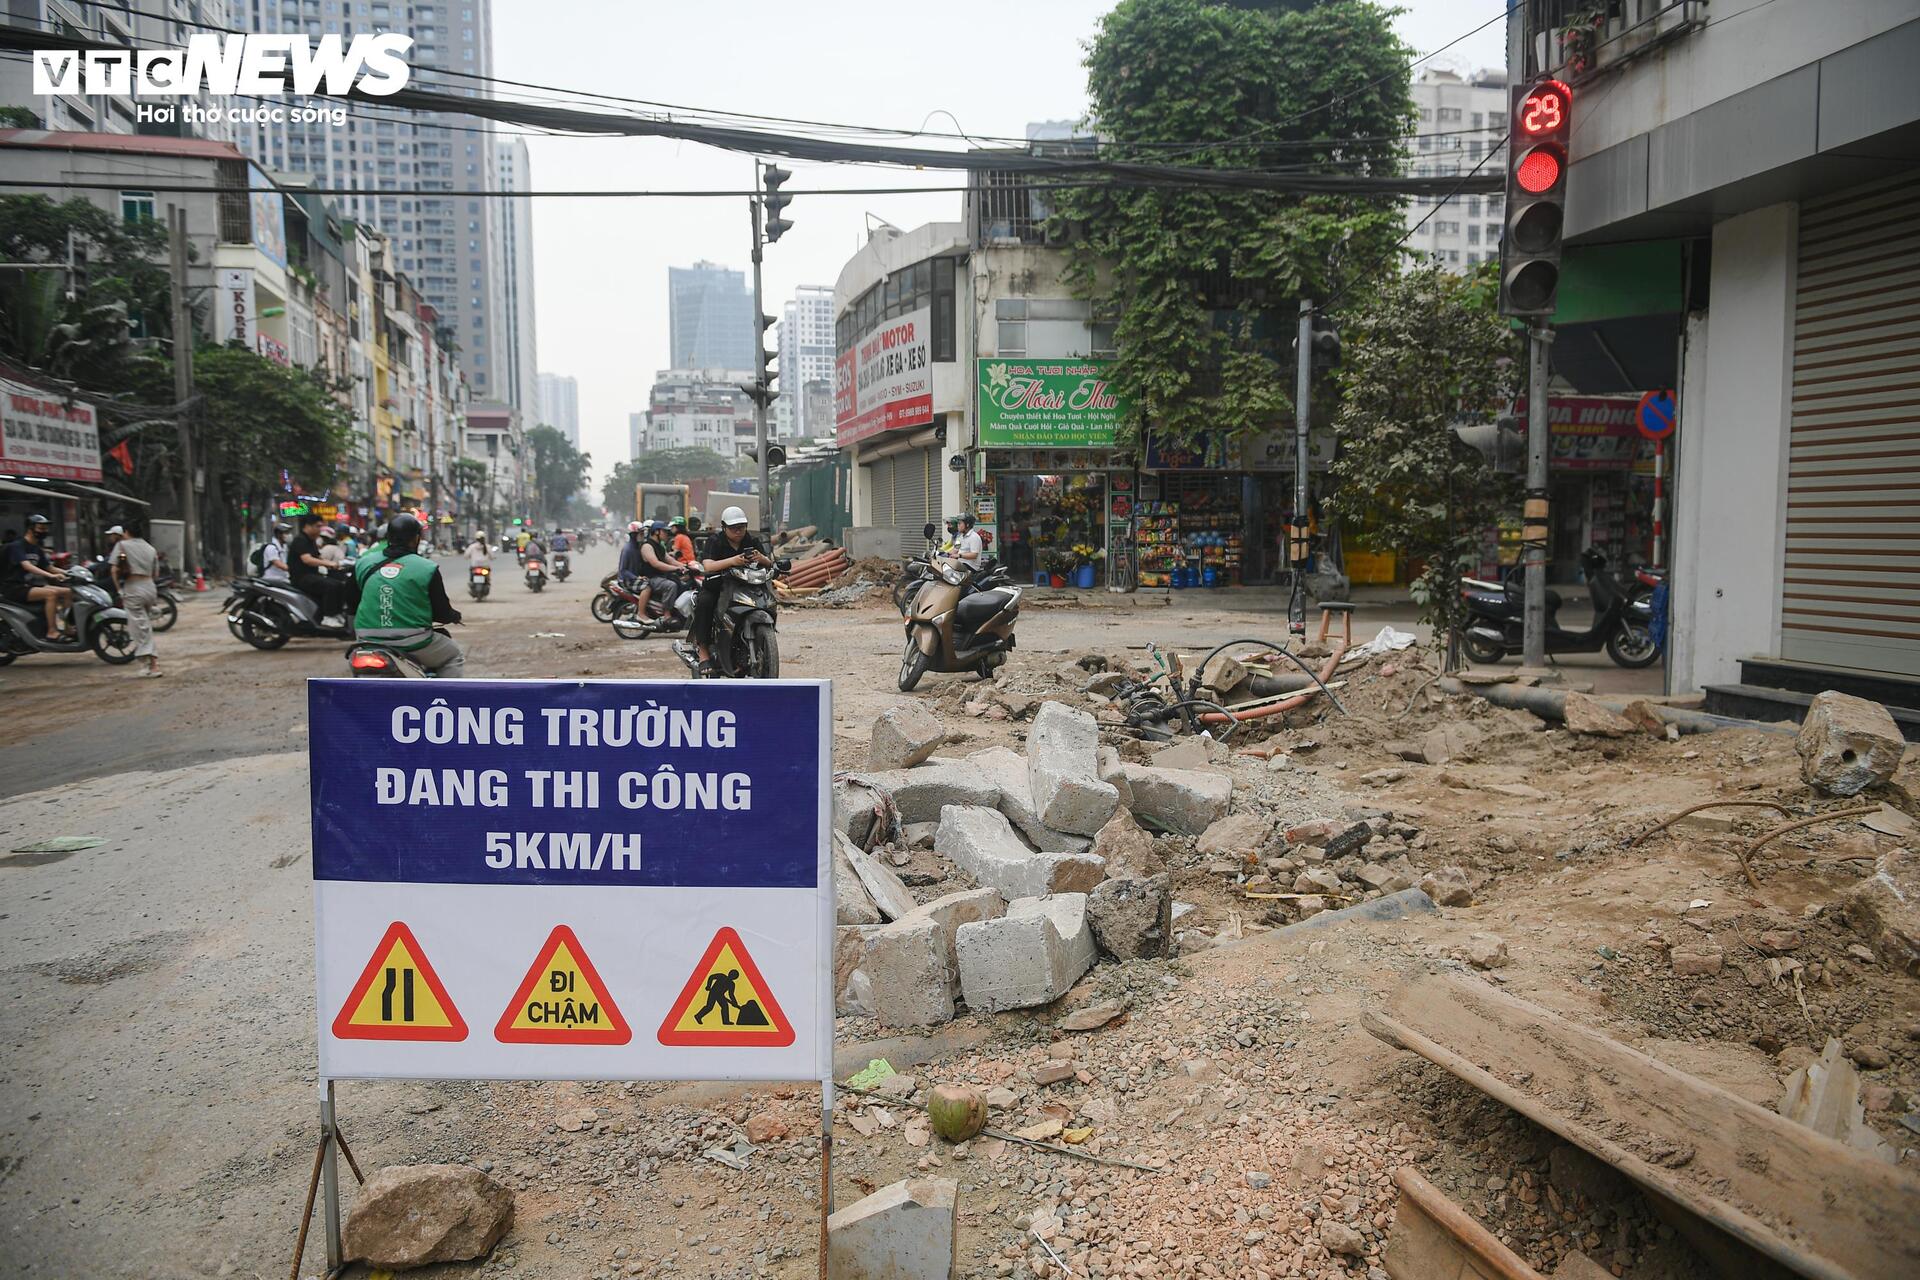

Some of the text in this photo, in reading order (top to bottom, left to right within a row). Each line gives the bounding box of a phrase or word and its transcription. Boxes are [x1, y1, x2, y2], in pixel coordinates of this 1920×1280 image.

[1525, 94, 1561, 131] 29
[233, 291, 246, 345] KORE
[881, 322, 915, 350] MOTOR
[908, 347, 916, 371] XE
[1008, 365, 1034, 376] HOA
[1066, 364, 1100, 378] NHẬP
[905, 380, 925, 394] SUZUKI
[1000, 412, 1025, 421] Chuyên
[1053, 412, 1067, 421] Hoa
[391, 698, 737, 748] CÔNG TRƯỜNG
[375, 764, 751, 811] ĐANG THI CÔNG
[485, 831, 642, 871] 5KM/H
[550, 970, 575, 993] ĐI
[527, 997, 599, 1029] CHẬM
